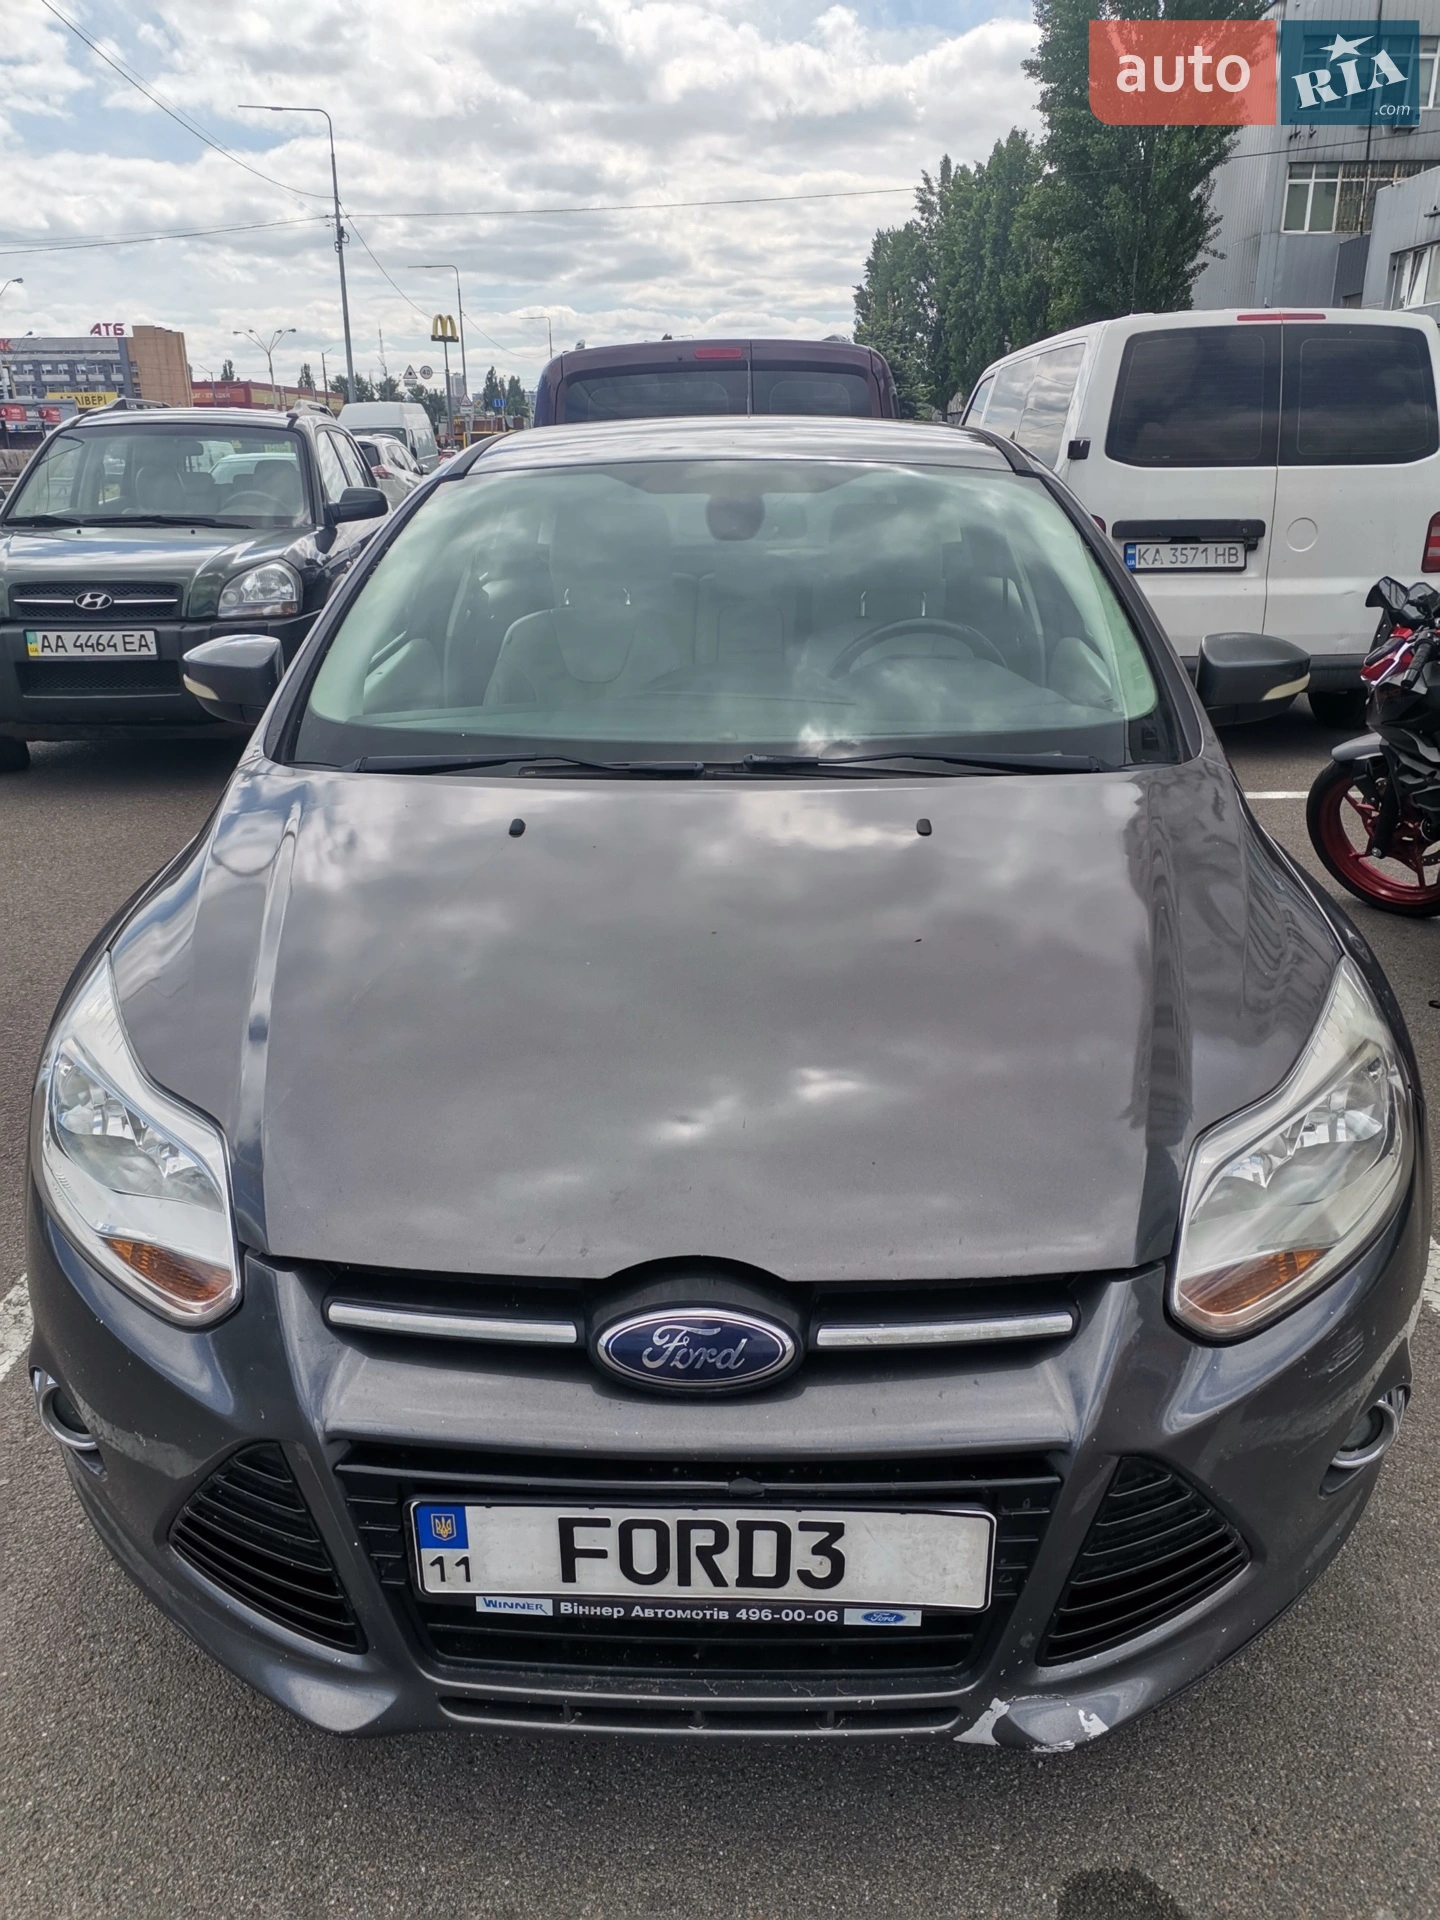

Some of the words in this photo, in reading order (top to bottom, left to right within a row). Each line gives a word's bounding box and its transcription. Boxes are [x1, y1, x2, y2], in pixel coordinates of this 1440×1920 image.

[90, 323, 125, 336] АТБ
[60, 395, 107, 406] ЛІВЕРІ
[1138, 548, 1164, 565] KA
[1169, 547, 1208, 564] 3571
[1214, 547, 1239, 564] HB
[41, 634, 68, 653] AA
[72, 634, 118, 653] 4464
[121, 634, 151, 652] EA
[641, 1324, 748, 1369] Ford
[558, 1516, 846, 1590] FORD3
[430, 1556, 471, 1582] 11
[483, 1597, 548, 1615] WINNER
[560, 1602, 625, 1618] Віннер
[735, 1608, 839, 1622] 496-00-06
[869, 1612, 896, 1622] Ford
